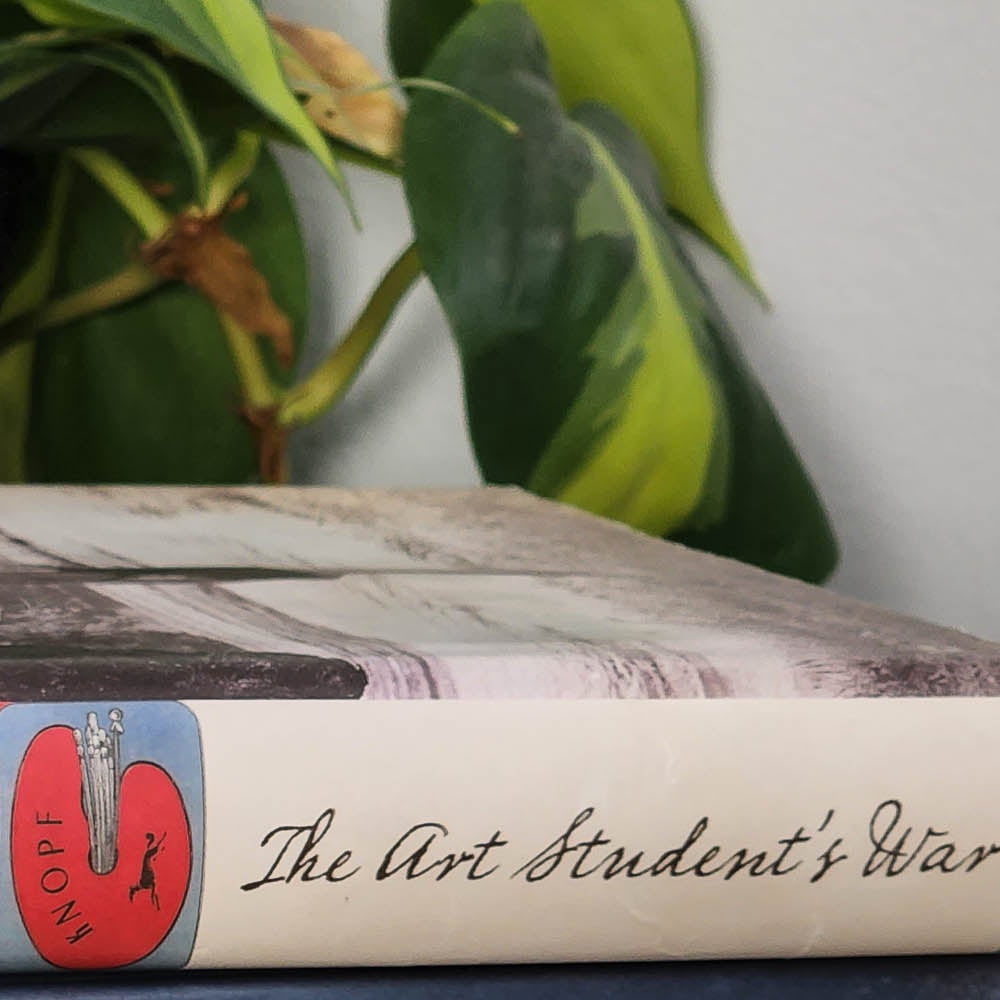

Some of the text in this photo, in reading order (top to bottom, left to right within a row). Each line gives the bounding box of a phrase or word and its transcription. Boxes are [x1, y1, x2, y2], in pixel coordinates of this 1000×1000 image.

[36, 810, 95, 945] KNOPF
[241, 800, 1000, 891] The Art Student's War
